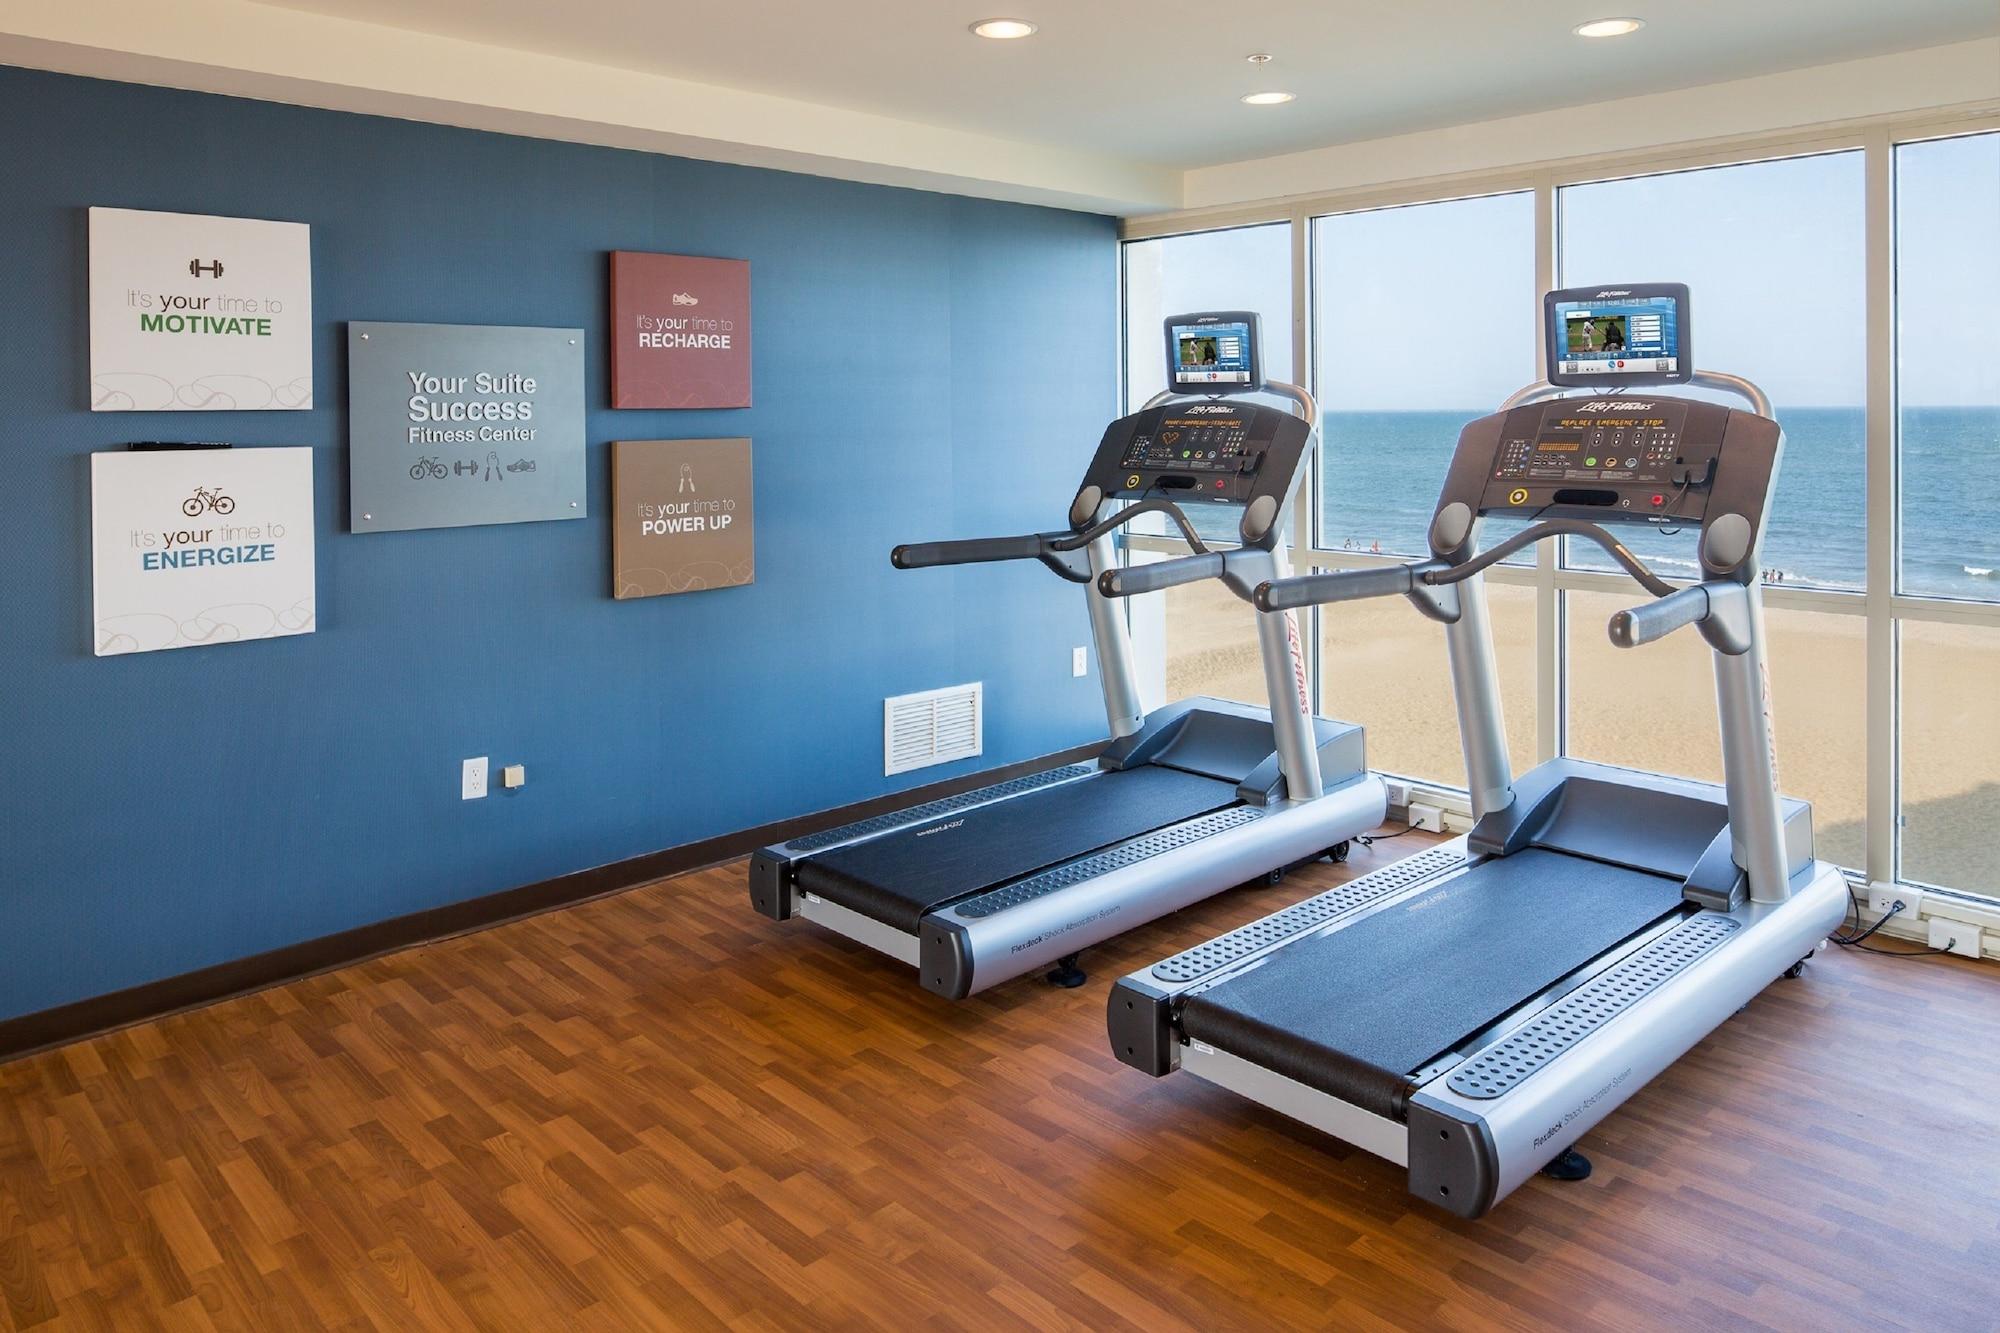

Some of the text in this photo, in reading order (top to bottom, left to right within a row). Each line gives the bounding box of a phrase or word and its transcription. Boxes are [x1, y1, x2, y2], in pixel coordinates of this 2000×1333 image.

[127, 288, 283, 314] It's your time to
[140, 313, 272, 336] MOTIVATE
[636, 314, 733, 332] It's your time to
[638, 332, 731, 349] RECHARGE
[408, 371, 537, 394] Your Suite
[407, 395, 533, 423] Success
[1643, 419, 1664, 427] STOP
[407, 426, 537, 444] Fitness Center
[637, 497, 736, 519] It's your time to
[130, 521, 286, 549] It's your time to
[642, 514, 732, 536] POWER UP
[143, 543, 276, 571] ENERGIZE
[1010, 935, 1043, 955] Flexdeck
[1044, 927, 1065, 941] Shock
[1533, 1120, 1563, 1150] Flexdeck
